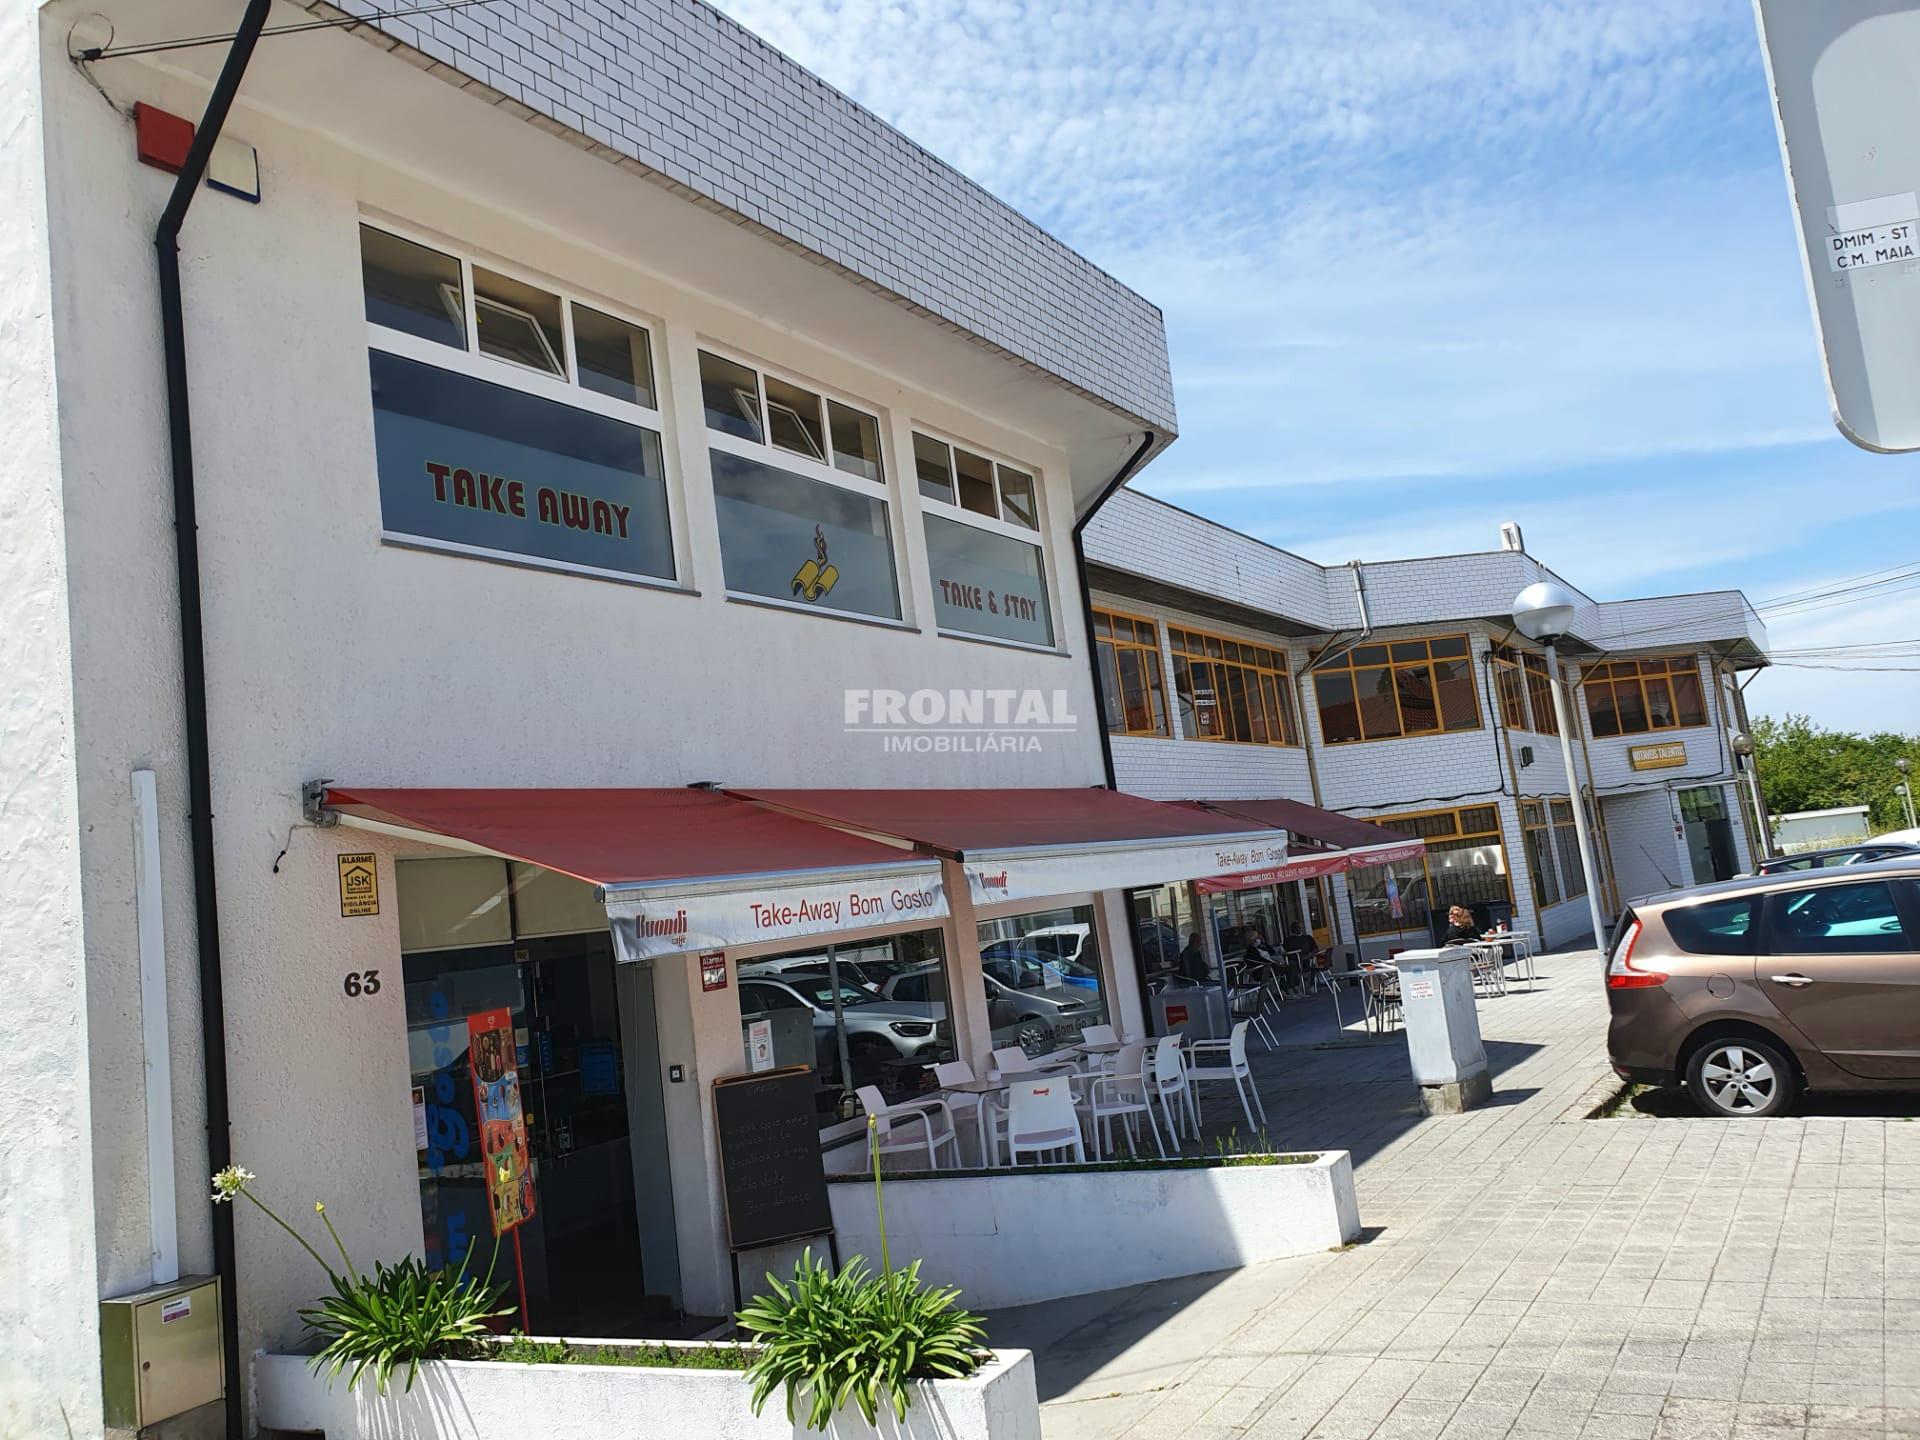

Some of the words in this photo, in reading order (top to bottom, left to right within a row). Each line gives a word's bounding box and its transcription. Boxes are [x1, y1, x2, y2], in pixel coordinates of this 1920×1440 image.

[1833, 232, 1874, 250] DMIM
[1891, 226, 1908, 240] ST
[1837, 253, 1869, 268] C.M.
[1875, 245, 1914, 262] MAIA
[425, 461, 527, 519] TAKE
[537, 487, 630, 540] AWAY
[940, 579, 982, 611] TAKE
[988, 590, 998, 614] &
[1004, 594, 1036, 622] STAY
[342, 856, 373, 864] ALARME
[1216, 850, 1248, 868] Take-Away
[1251, 850, 1265, 863] Bom
[347, 875, 369, 886] JSK
[750, 900, 841, 928] Take-Away
[850, 894, 884, 916] Bom
[891, 888, 932, 910] Gosto
[636, 910, 687, 938] Buondi
[344, 970, 381, 997] 63
